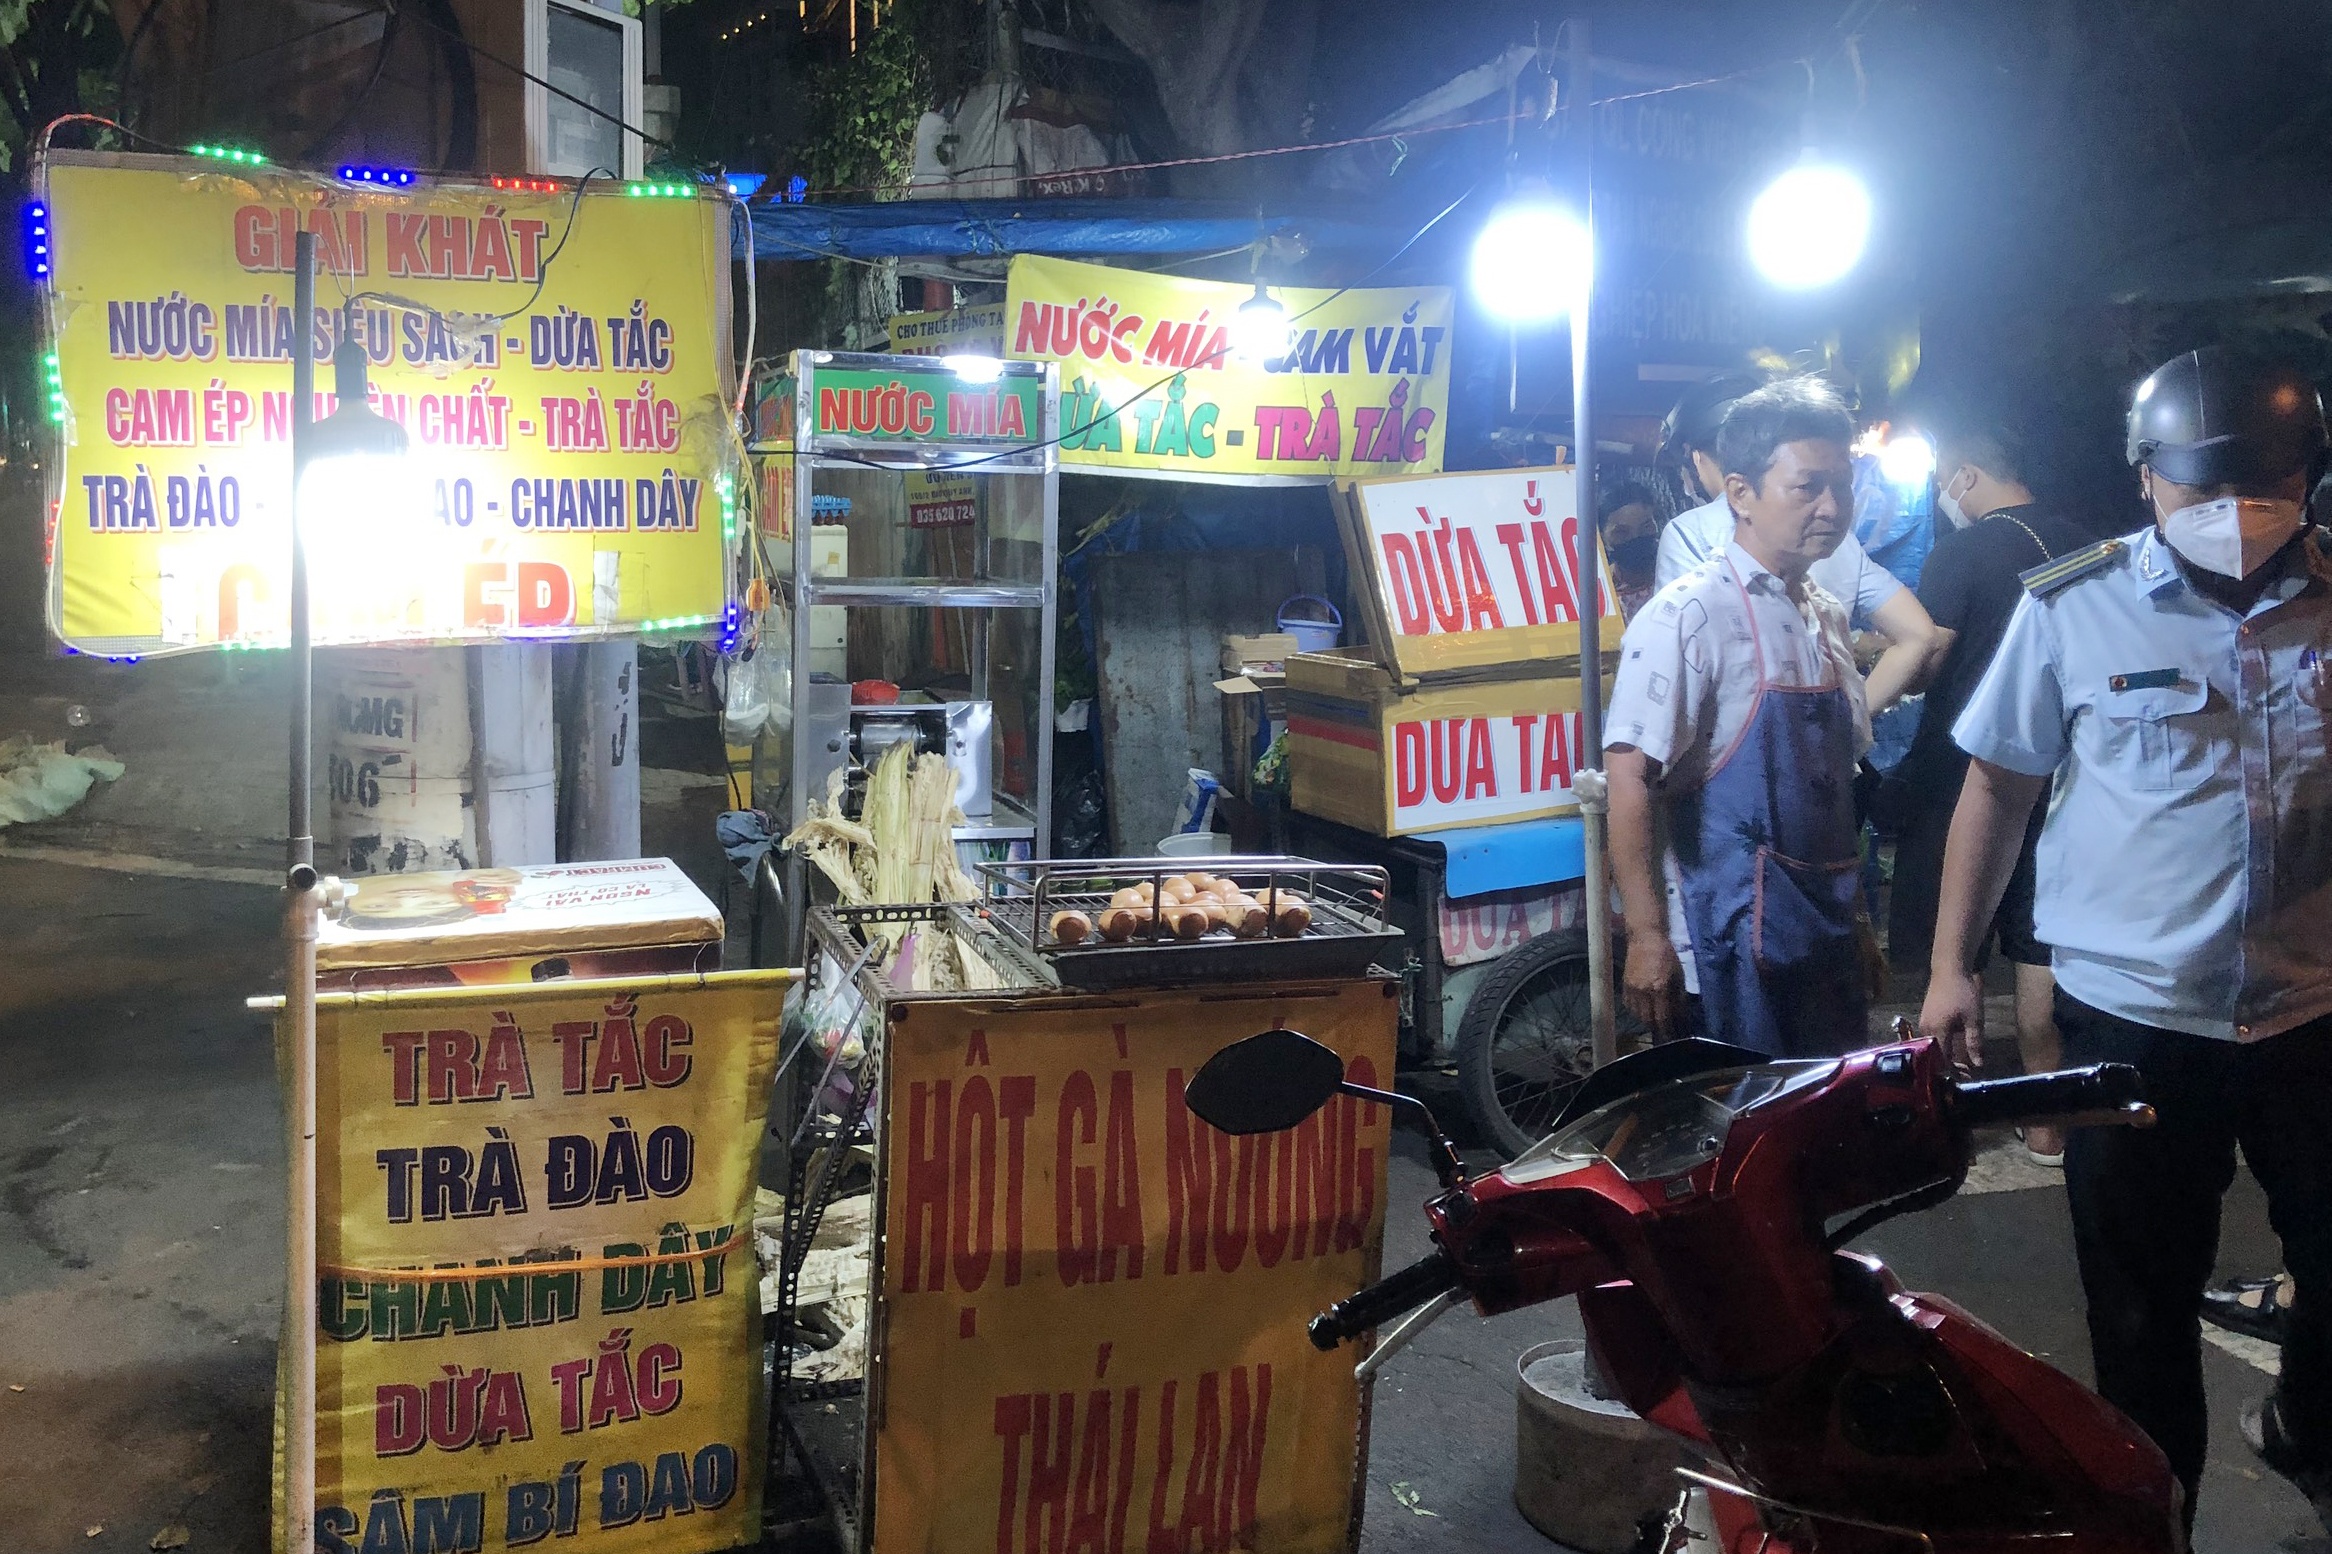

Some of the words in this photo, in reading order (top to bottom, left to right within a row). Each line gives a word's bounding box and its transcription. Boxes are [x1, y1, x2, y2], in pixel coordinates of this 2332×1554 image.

[234, 191, 368, 276] GIẢI
[385, 204, 548, 282] KHÁT
[107, 291, 218, 362] NƯỚC
[225, 294, 298, 363] MÍA
[530, 304, 604, 372] DỪA
[607, 299, 675, 373] TẮC
[1014, 296, 1144, 363] NƯỚC
[1143, 309, 1229, 370] MÍA
[1364, 300, 1446, 375] VẮT
[106, 386, 197, 448] CAM
[203, 378, 256, 447] ÉP
[419, 377, 513, 451] CHẤT
[541, 387, 611, 453] TRÀ
[614, 379, 681, 454] TẮC
[819, 382, 935, 437] NƯỚC
[947, 386, 1028, 438] MÍA
[1060, 375, 1123, 453] ỪA
[1133, 374, 1221, 459] TẮC
[1254, 388, 1340, 461] TRÀ
[1350, 377, 1437, 464] TẮC
[82, 463, 162, 534] TRÀ
[167, 463, 241, 531] ĐÀO
[511, 477, 631, 533] CHANH
[635, 467, 703, 533] DÂY
[1381, 505, 1505, 637] DỪA
[1511, 709, 1584, 794] TA
[382, 1010, 535, 1108] TRÀ
[551, 990, 694, 1096] TẮC
[375, 1125, 528, 1224] TRÀ
[544, 1116, 695, 1211] ĐÀO
[901, 1028, 1036, 1340] HỘT
[1055, 1022, 1145, 1288] GÀ
[318, 1246, 582, 1342] CHANH
[602, 1222, 735, 1316] DÂY
[375, 1363, 533, 1459] DỪA
[551, 1327, 684, 1435] TẮC
[993, 1340, 1140, 1554] THÁI
[1146, 1363, 1273, 1554] LAN
[315, 1487, 486, 1554] SÂM
[505, 1459, 588, 1548] BÍ
[600, 1441, 738, 1531] ĐAO
